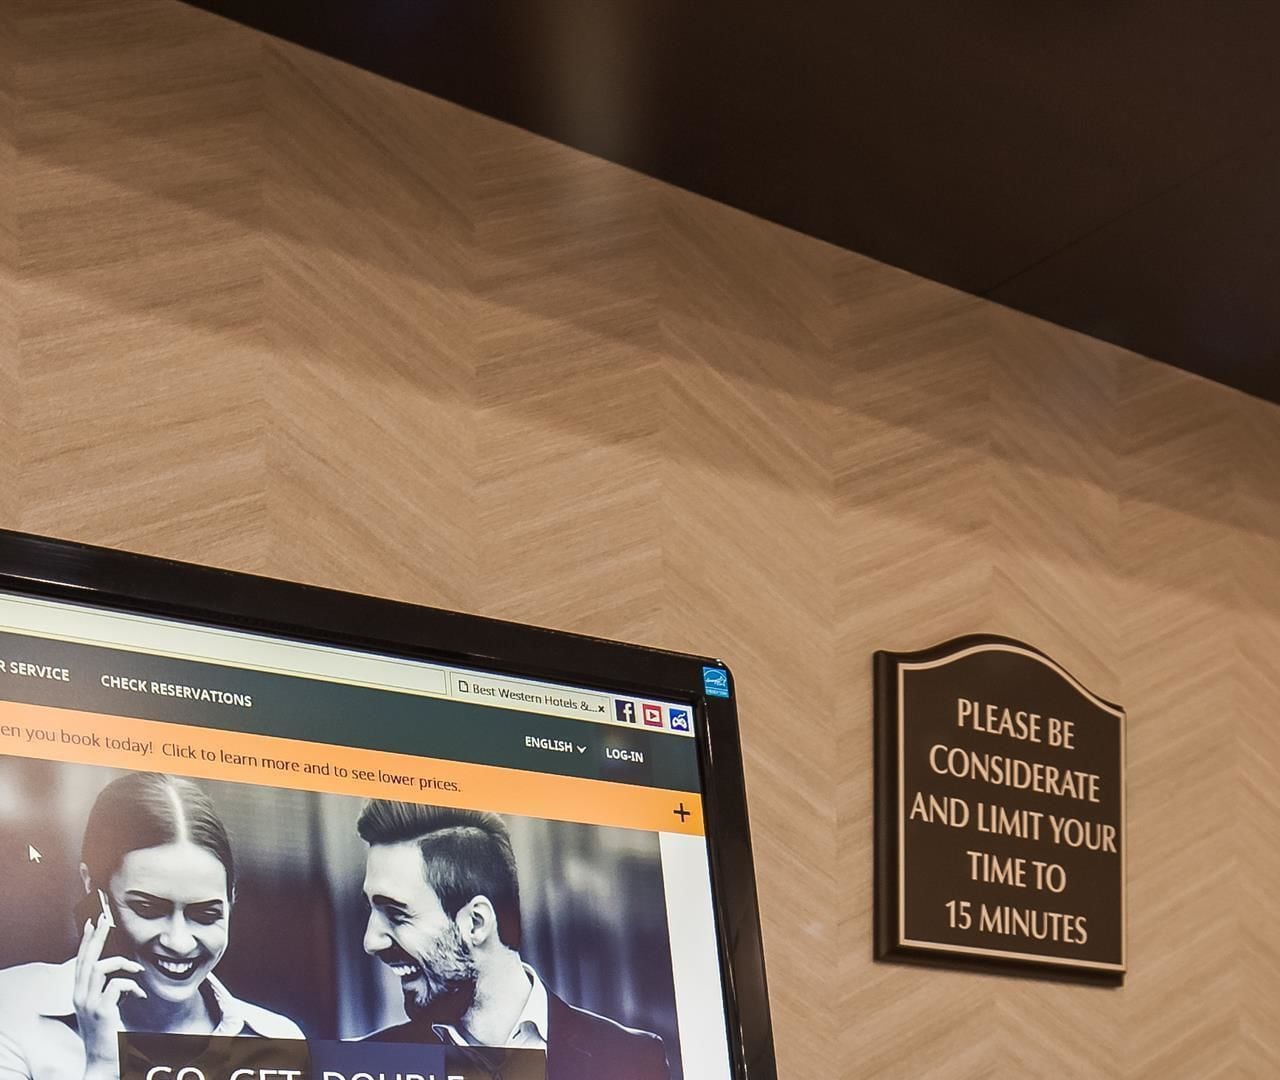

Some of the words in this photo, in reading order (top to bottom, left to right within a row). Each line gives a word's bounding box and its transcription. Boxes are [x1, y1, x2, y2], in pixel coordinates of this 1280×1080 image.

[10, 661, 70, 682] SERVICE
[100, 674, 148, 693] CHECK
[150, 682, 252, 708] RESERVATIONS
[472, 684, 496, 697] Best
[498, 688, 542, 704] Western
[545, 694, 578, 710] Hotels
[525, 736, 572, 752] ENGLISH
[957, 698, 1041, 743] PLEASE
[1049, 717, 1075, 749] BE
[24, 727, 56, 744] you
[60, 729, 101, 748] book
[104, 735, 154, 756] today!
[161, 742, 197, 760] Click
[200, 747, 216, 763] to
[219, 748, 258, 766] learn
[261, 757, 300, 772] more
[303, 758, 330, 775] and
[333, 764, 349, 778] to
[351, 768, 375, 781] see
[378, 769, 415, 786] lower
[418, 775, 462, 795] prices.
[606, 747, 644, 763] LOG-IN
[929, 744, 1100, 802] CONSIDERATE
[910, 792, 969, 828] AND
[977, 802, 1044, 841] LIMIT
[1049, 816, 1117, 853] YOUR
[967, 851, 1027, 888] TIME
[1031, 861, 1066, 893] TO
[945, 900, 971, 930] 15
[978, 903, 1088, 945] MINUTES
